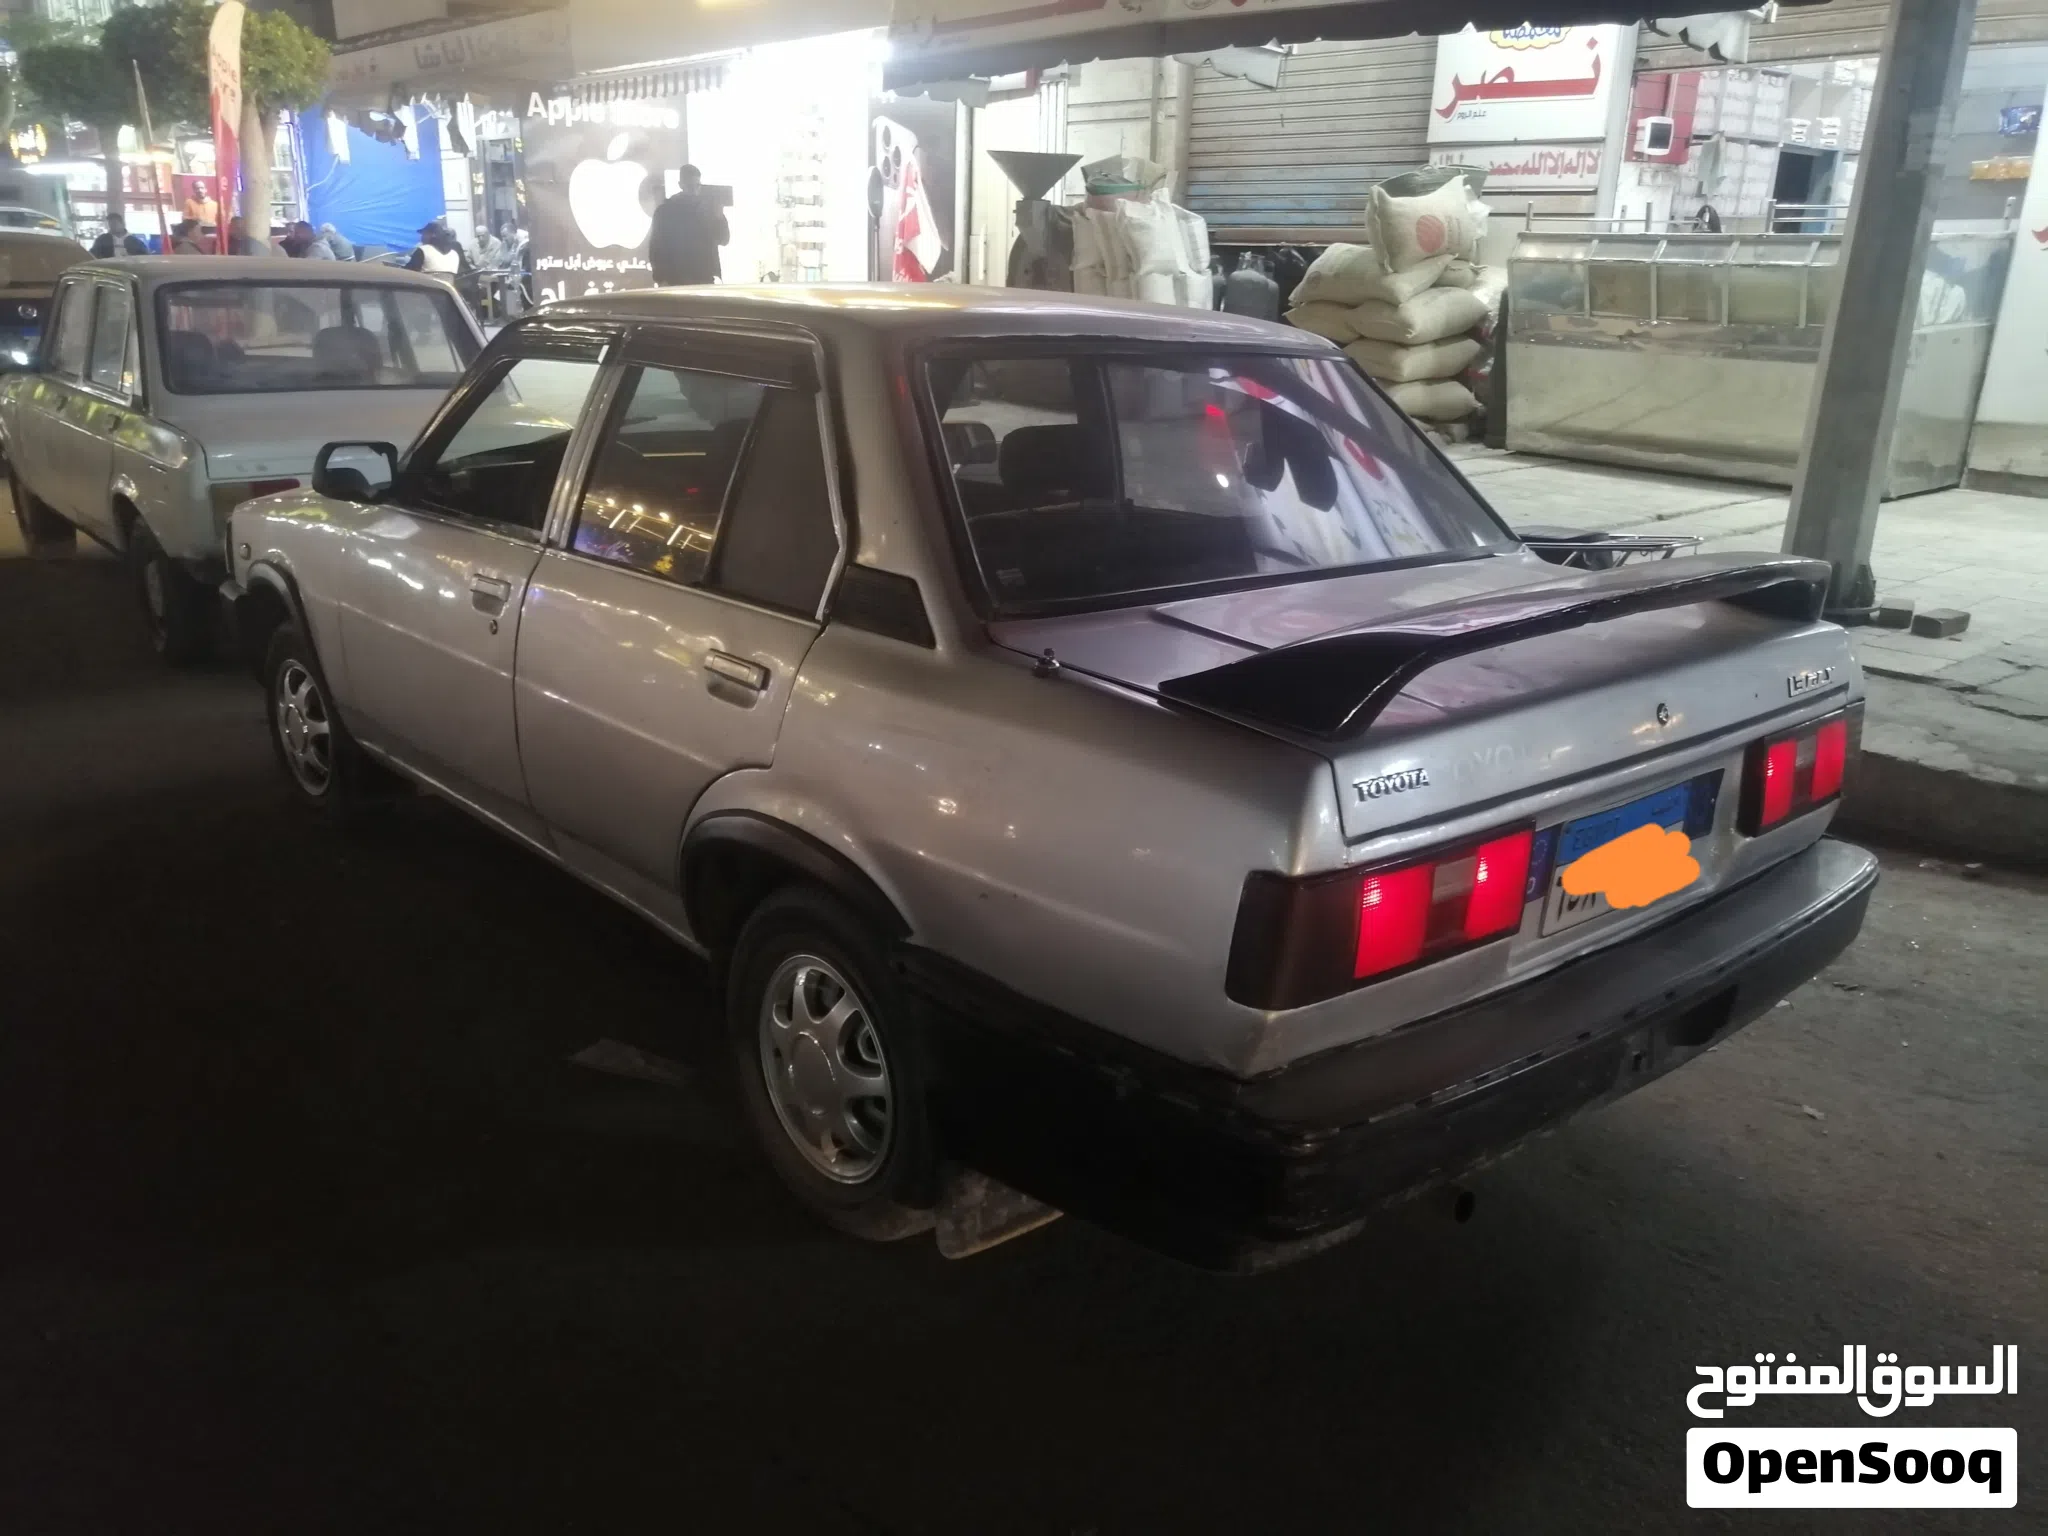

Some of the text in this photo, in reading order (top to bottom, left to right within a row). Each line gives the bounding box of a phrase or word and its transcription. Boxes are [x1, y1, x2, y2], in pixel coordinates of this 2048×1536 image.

[1435, 37, 1601, 119] نصر
[527, 91, 606, 127] Apple
[1352, 767, 1430, 802] TOYOTA
